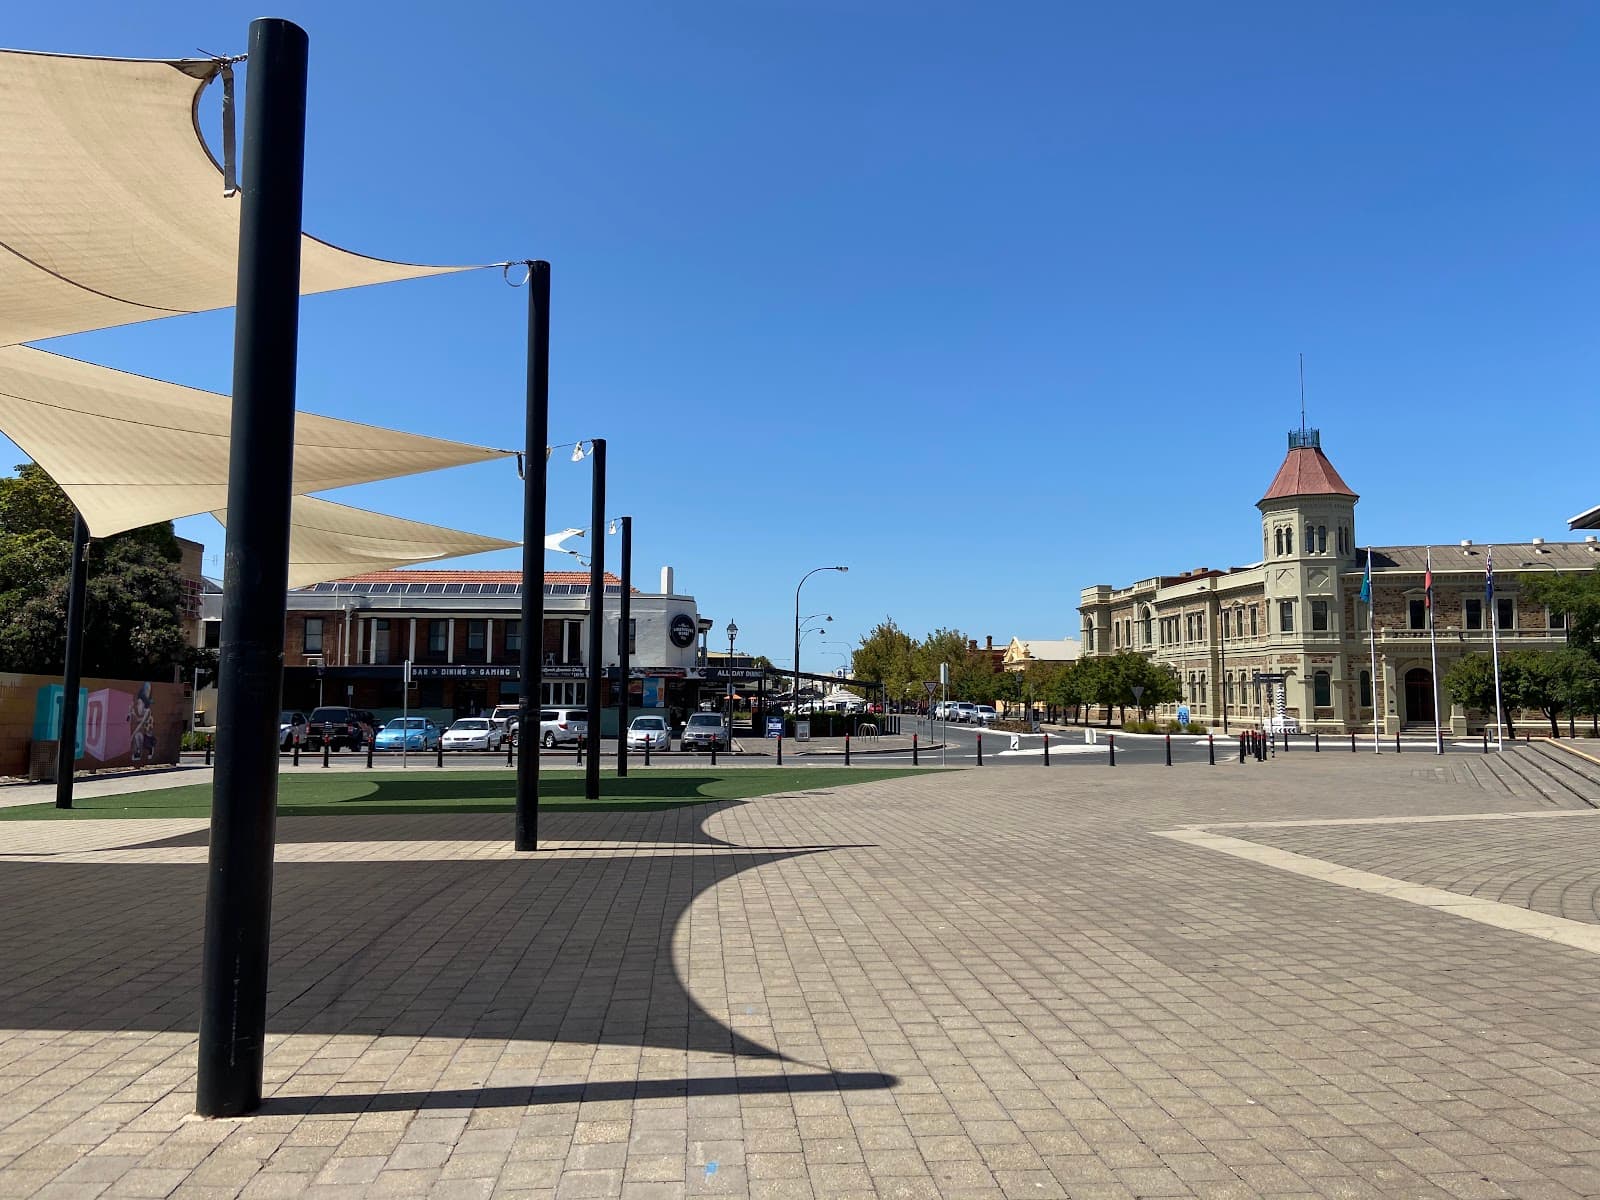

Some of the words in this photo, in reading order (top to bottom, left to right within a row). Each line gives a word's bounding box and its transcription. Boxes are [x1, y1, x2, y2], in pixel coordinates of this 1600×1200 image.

[412, 668, 428, 676] BAR
[441, 668, 467, 676] DINING
[479, 668, 511, 676] GAMING
[717, 669, 730, 677] ALL
[731, 669, 745, 677] DAY
